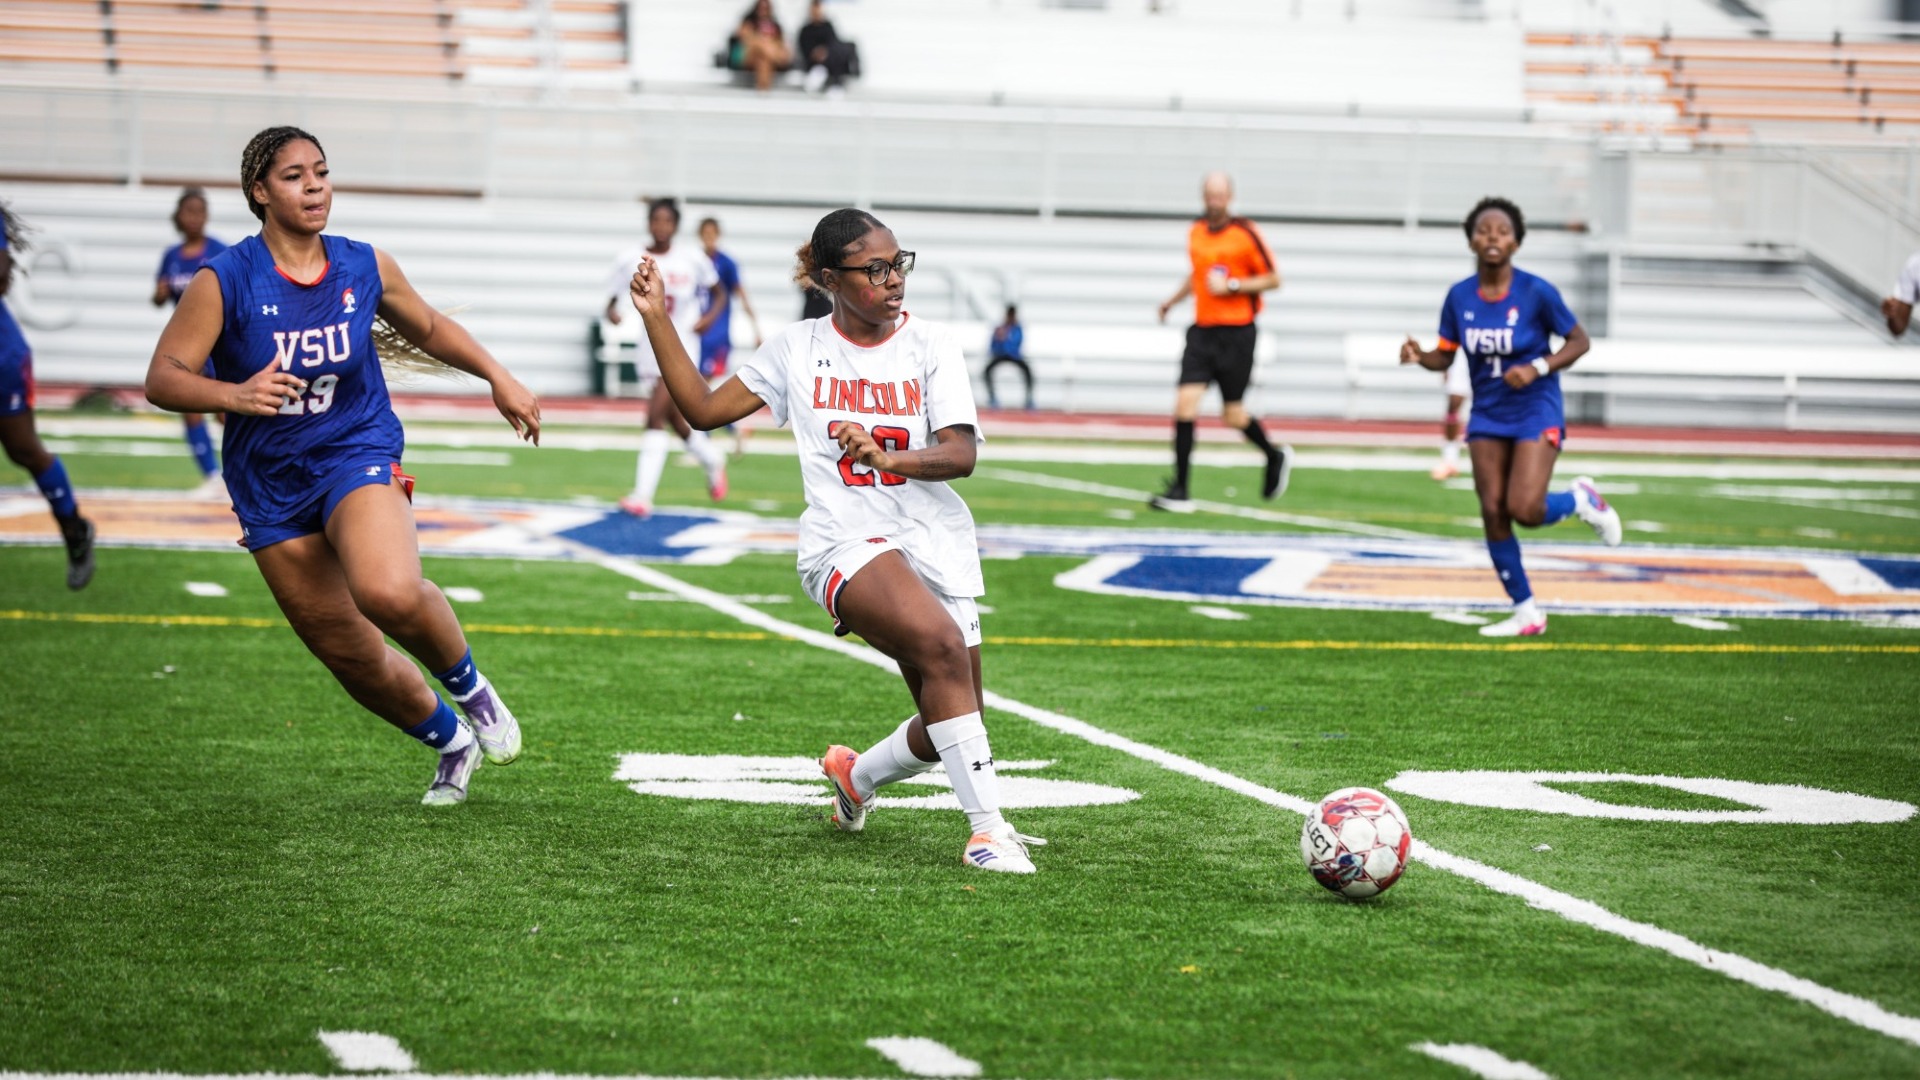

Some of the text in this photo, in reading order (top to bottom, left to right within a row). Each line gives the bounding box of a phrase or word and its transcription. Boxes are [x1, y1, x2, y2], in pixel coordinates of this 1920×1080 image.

[273, 321, 351, 371] VSU
[1465, 328, 1512, 354] VSU
[277, 374, 339, 414] 29
[812, 376, 922, 416] LINCOLN
